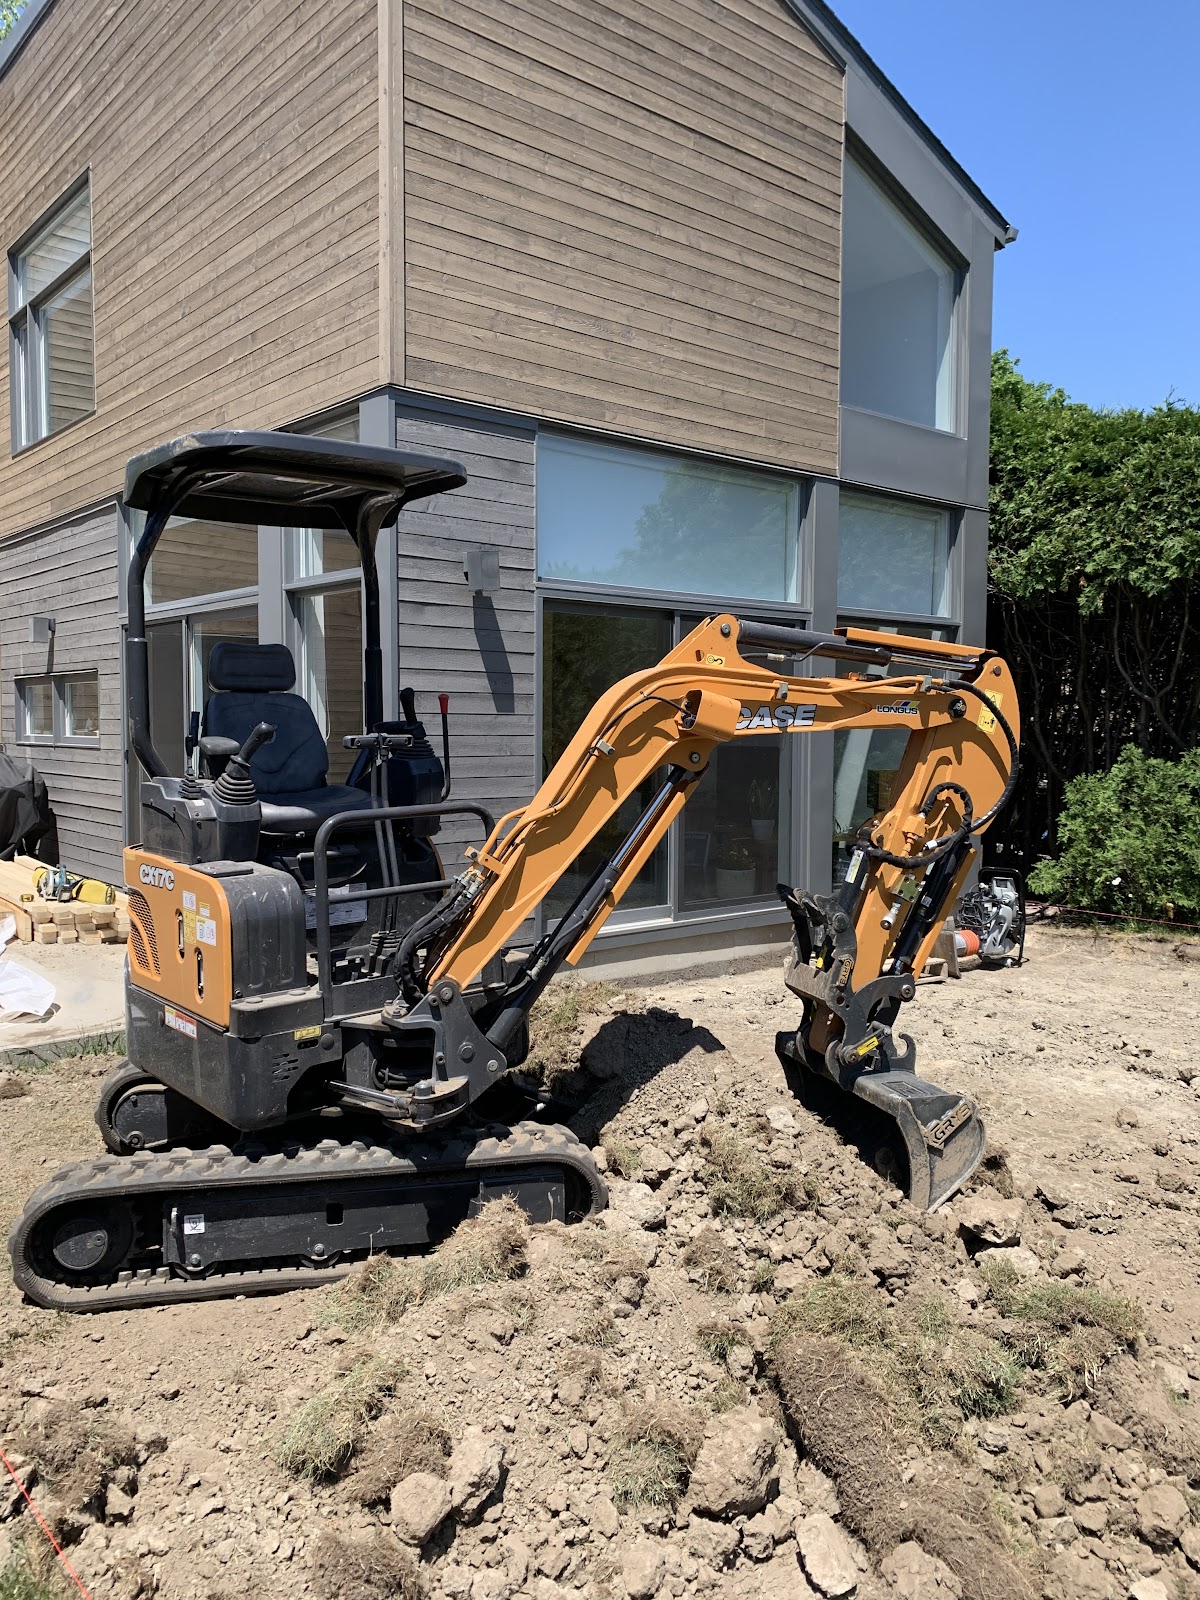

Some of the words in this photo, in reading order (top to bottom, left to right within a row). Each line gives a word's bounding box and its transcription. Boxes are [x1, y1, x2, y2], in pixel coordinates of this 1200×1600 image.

[736, 704, 817, 730] CASE
[876, 705, 919, 715] LONGUS
[140, 863, 175, 891] CX17C
